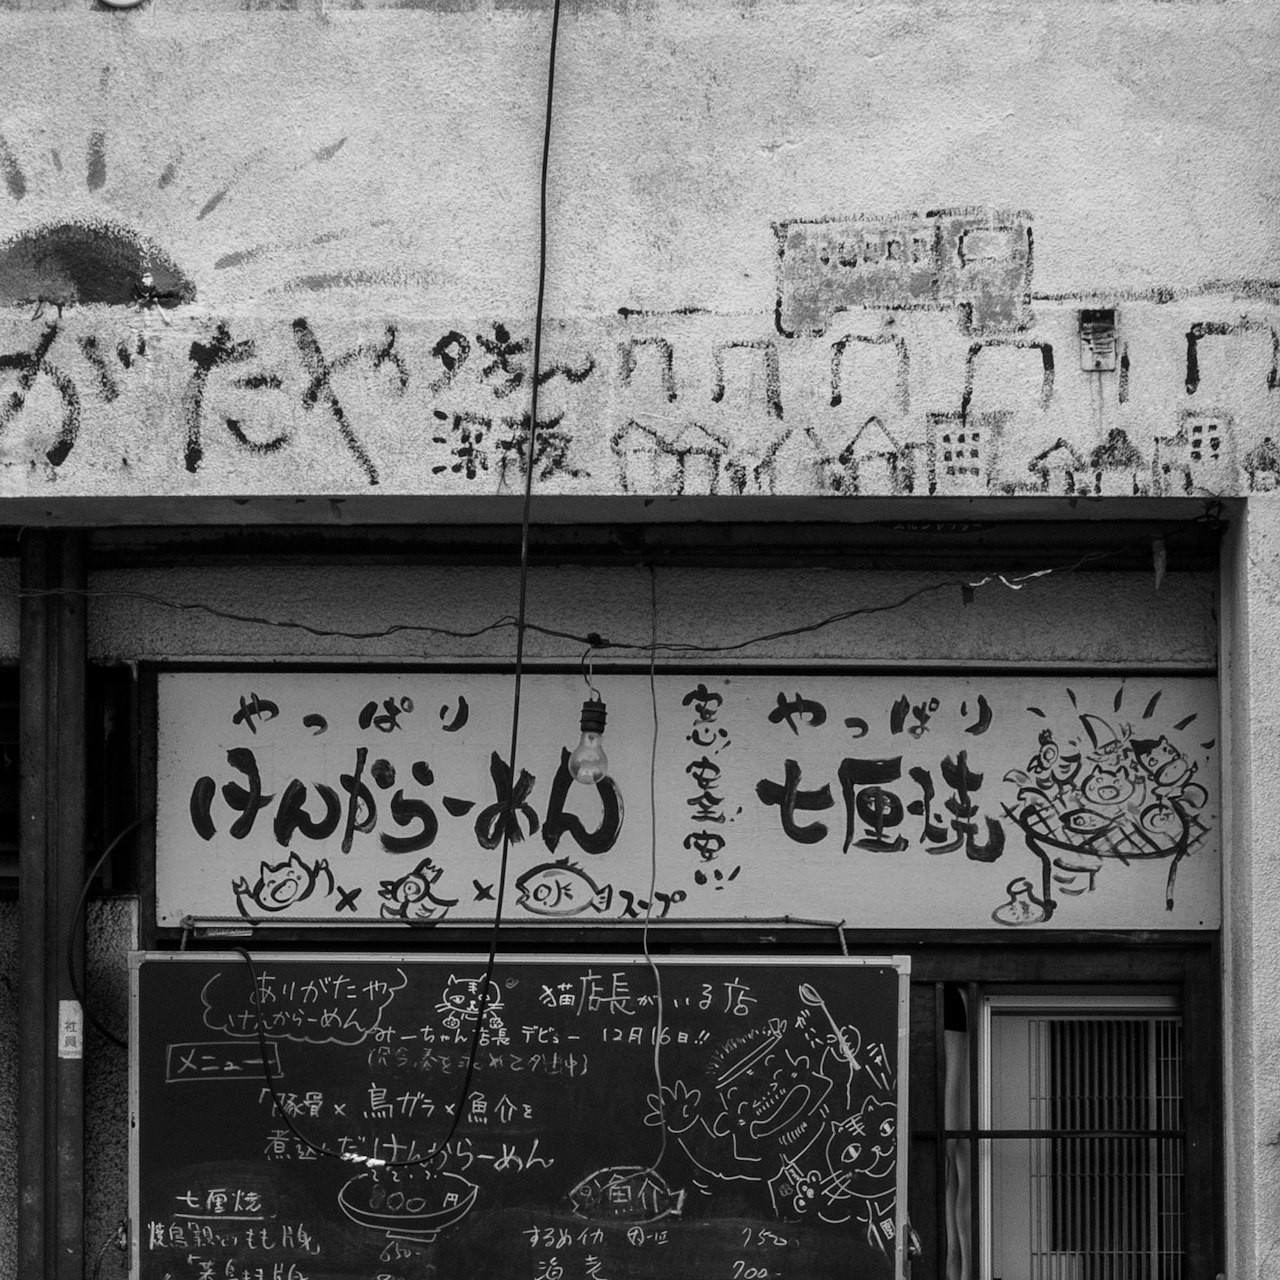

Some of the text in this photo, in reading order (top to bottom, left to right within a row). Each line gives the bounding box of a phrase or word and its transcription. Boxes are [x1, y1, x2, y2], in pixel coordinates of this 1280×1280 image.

[232, 692, 470, 736] やっぱり
[768, 692, 993, 738] やっぱり
[189, 746, 624, 855] けんからーめん
[618, 889, 687, 919] スープ
[250, 971, 388, 1005] ありがたや
[539, 970, 758, 1016] 猫店長がいる店
[522, 1025, 580, 1044] デビュー
[177, 1050, 276, 1074] メニュー
[523, 1226, 604, 1250] するめイカ
